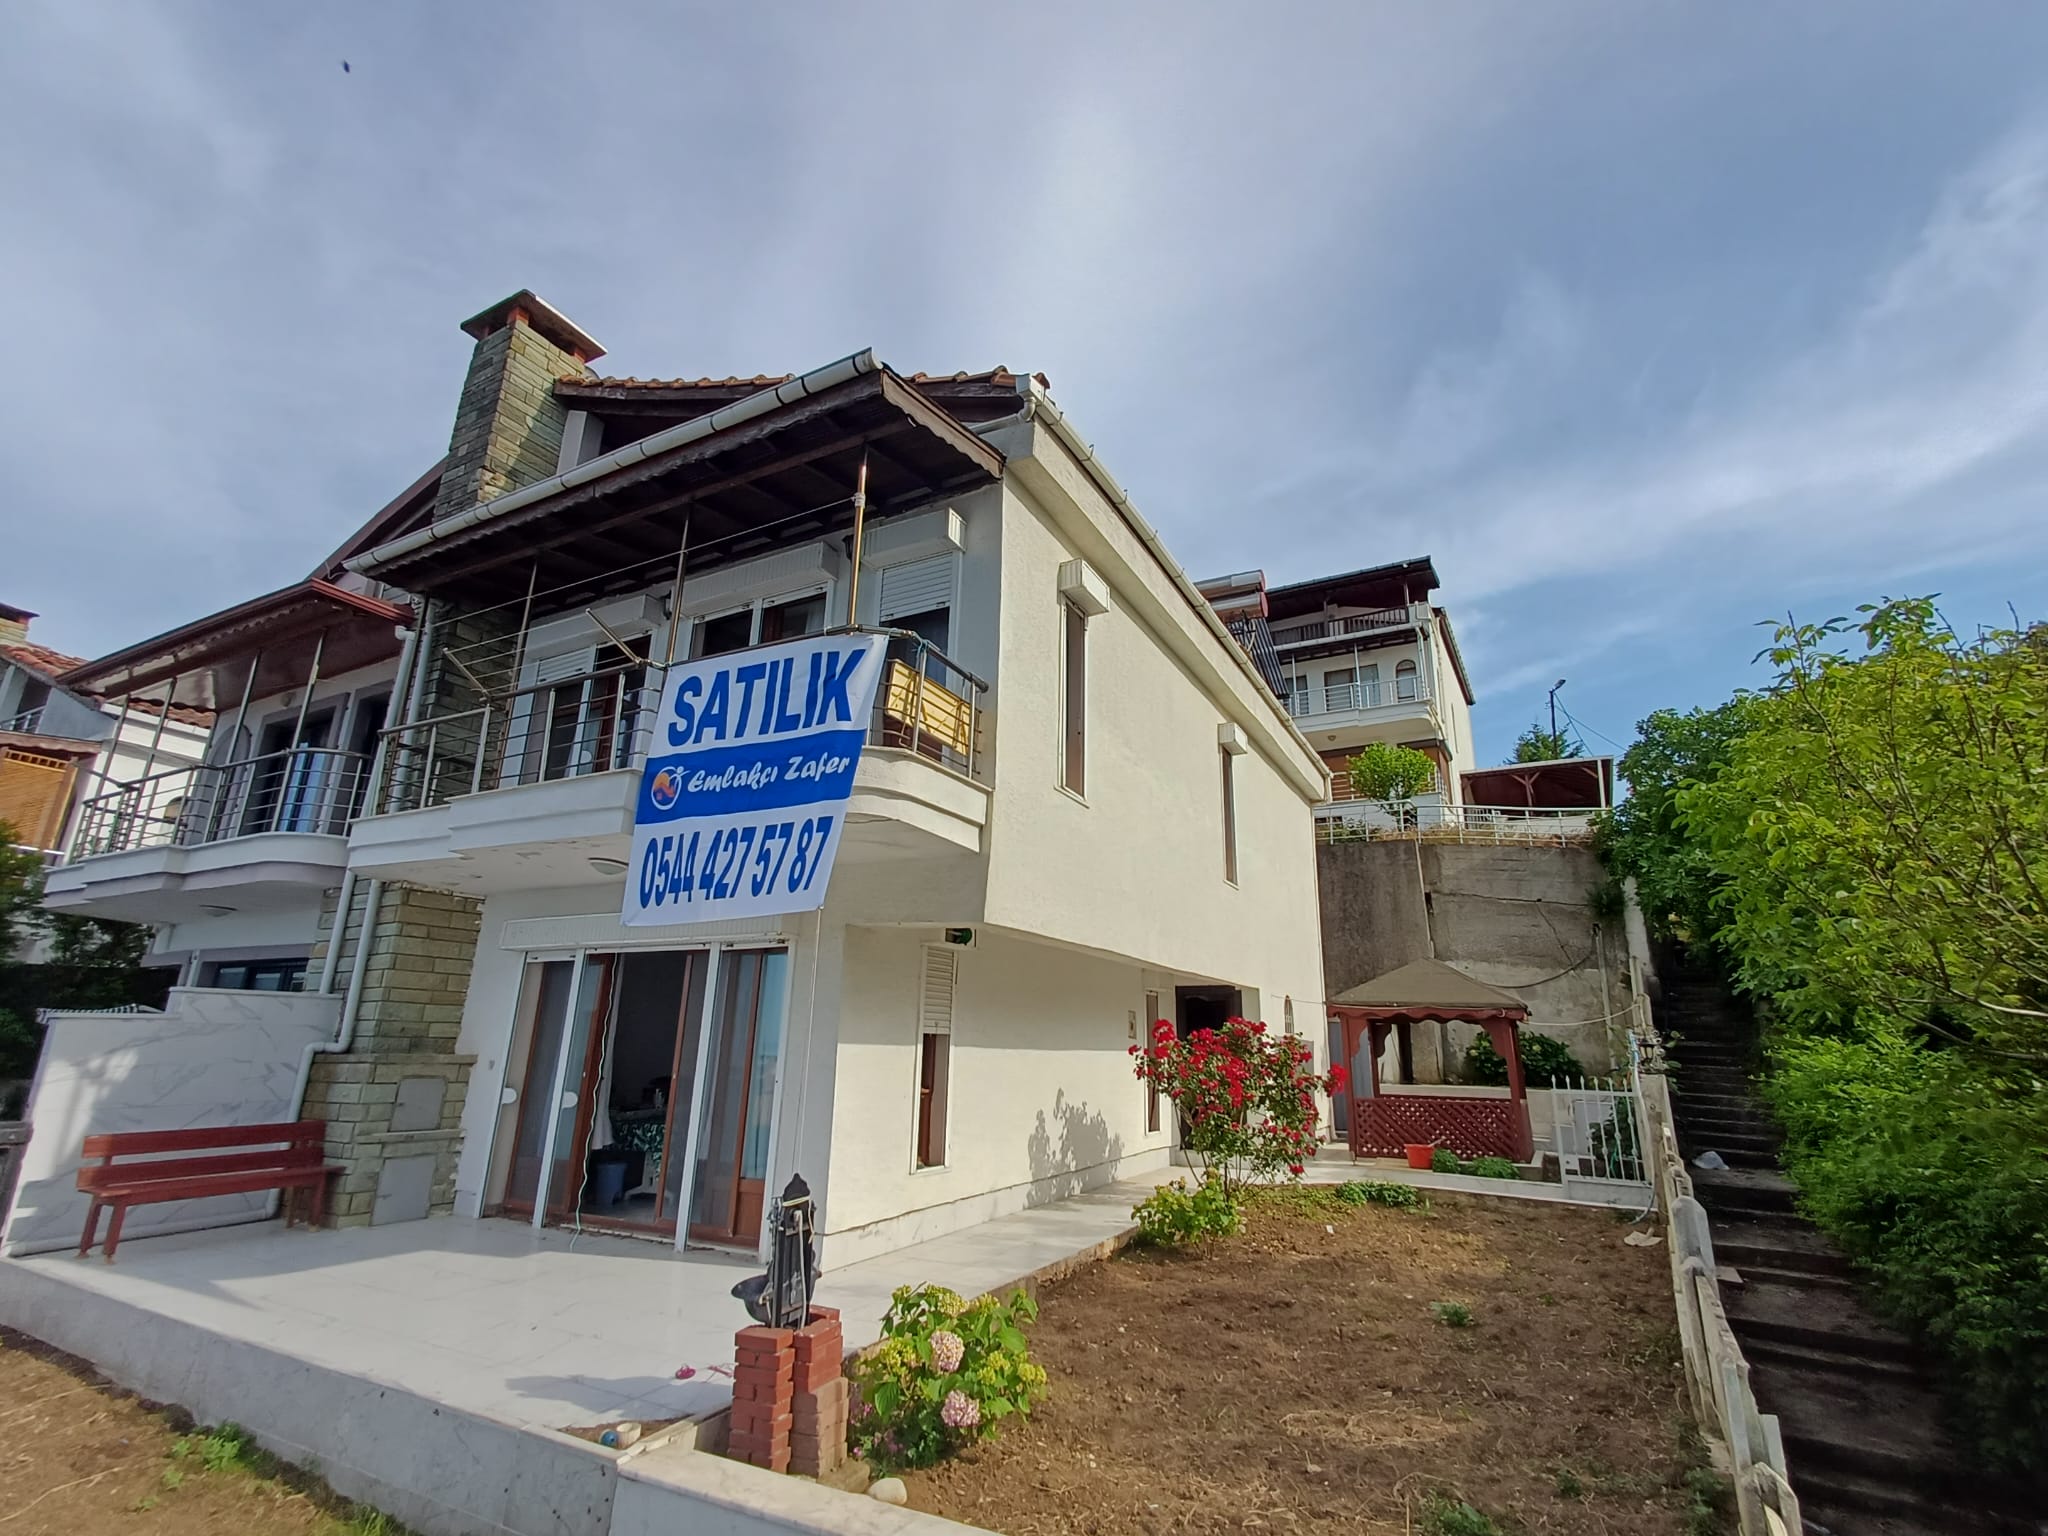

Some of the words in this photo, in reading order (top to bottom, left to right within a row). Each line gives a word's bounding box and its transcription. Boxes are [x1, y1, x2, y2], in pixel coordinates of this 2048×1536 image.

[668, 649, 866, 747] SATILIK
[687, 761, 778, 793] Emlakçı
[784, 752, 850, 784] Zafer
[639, 831, 700, 909] 0544
